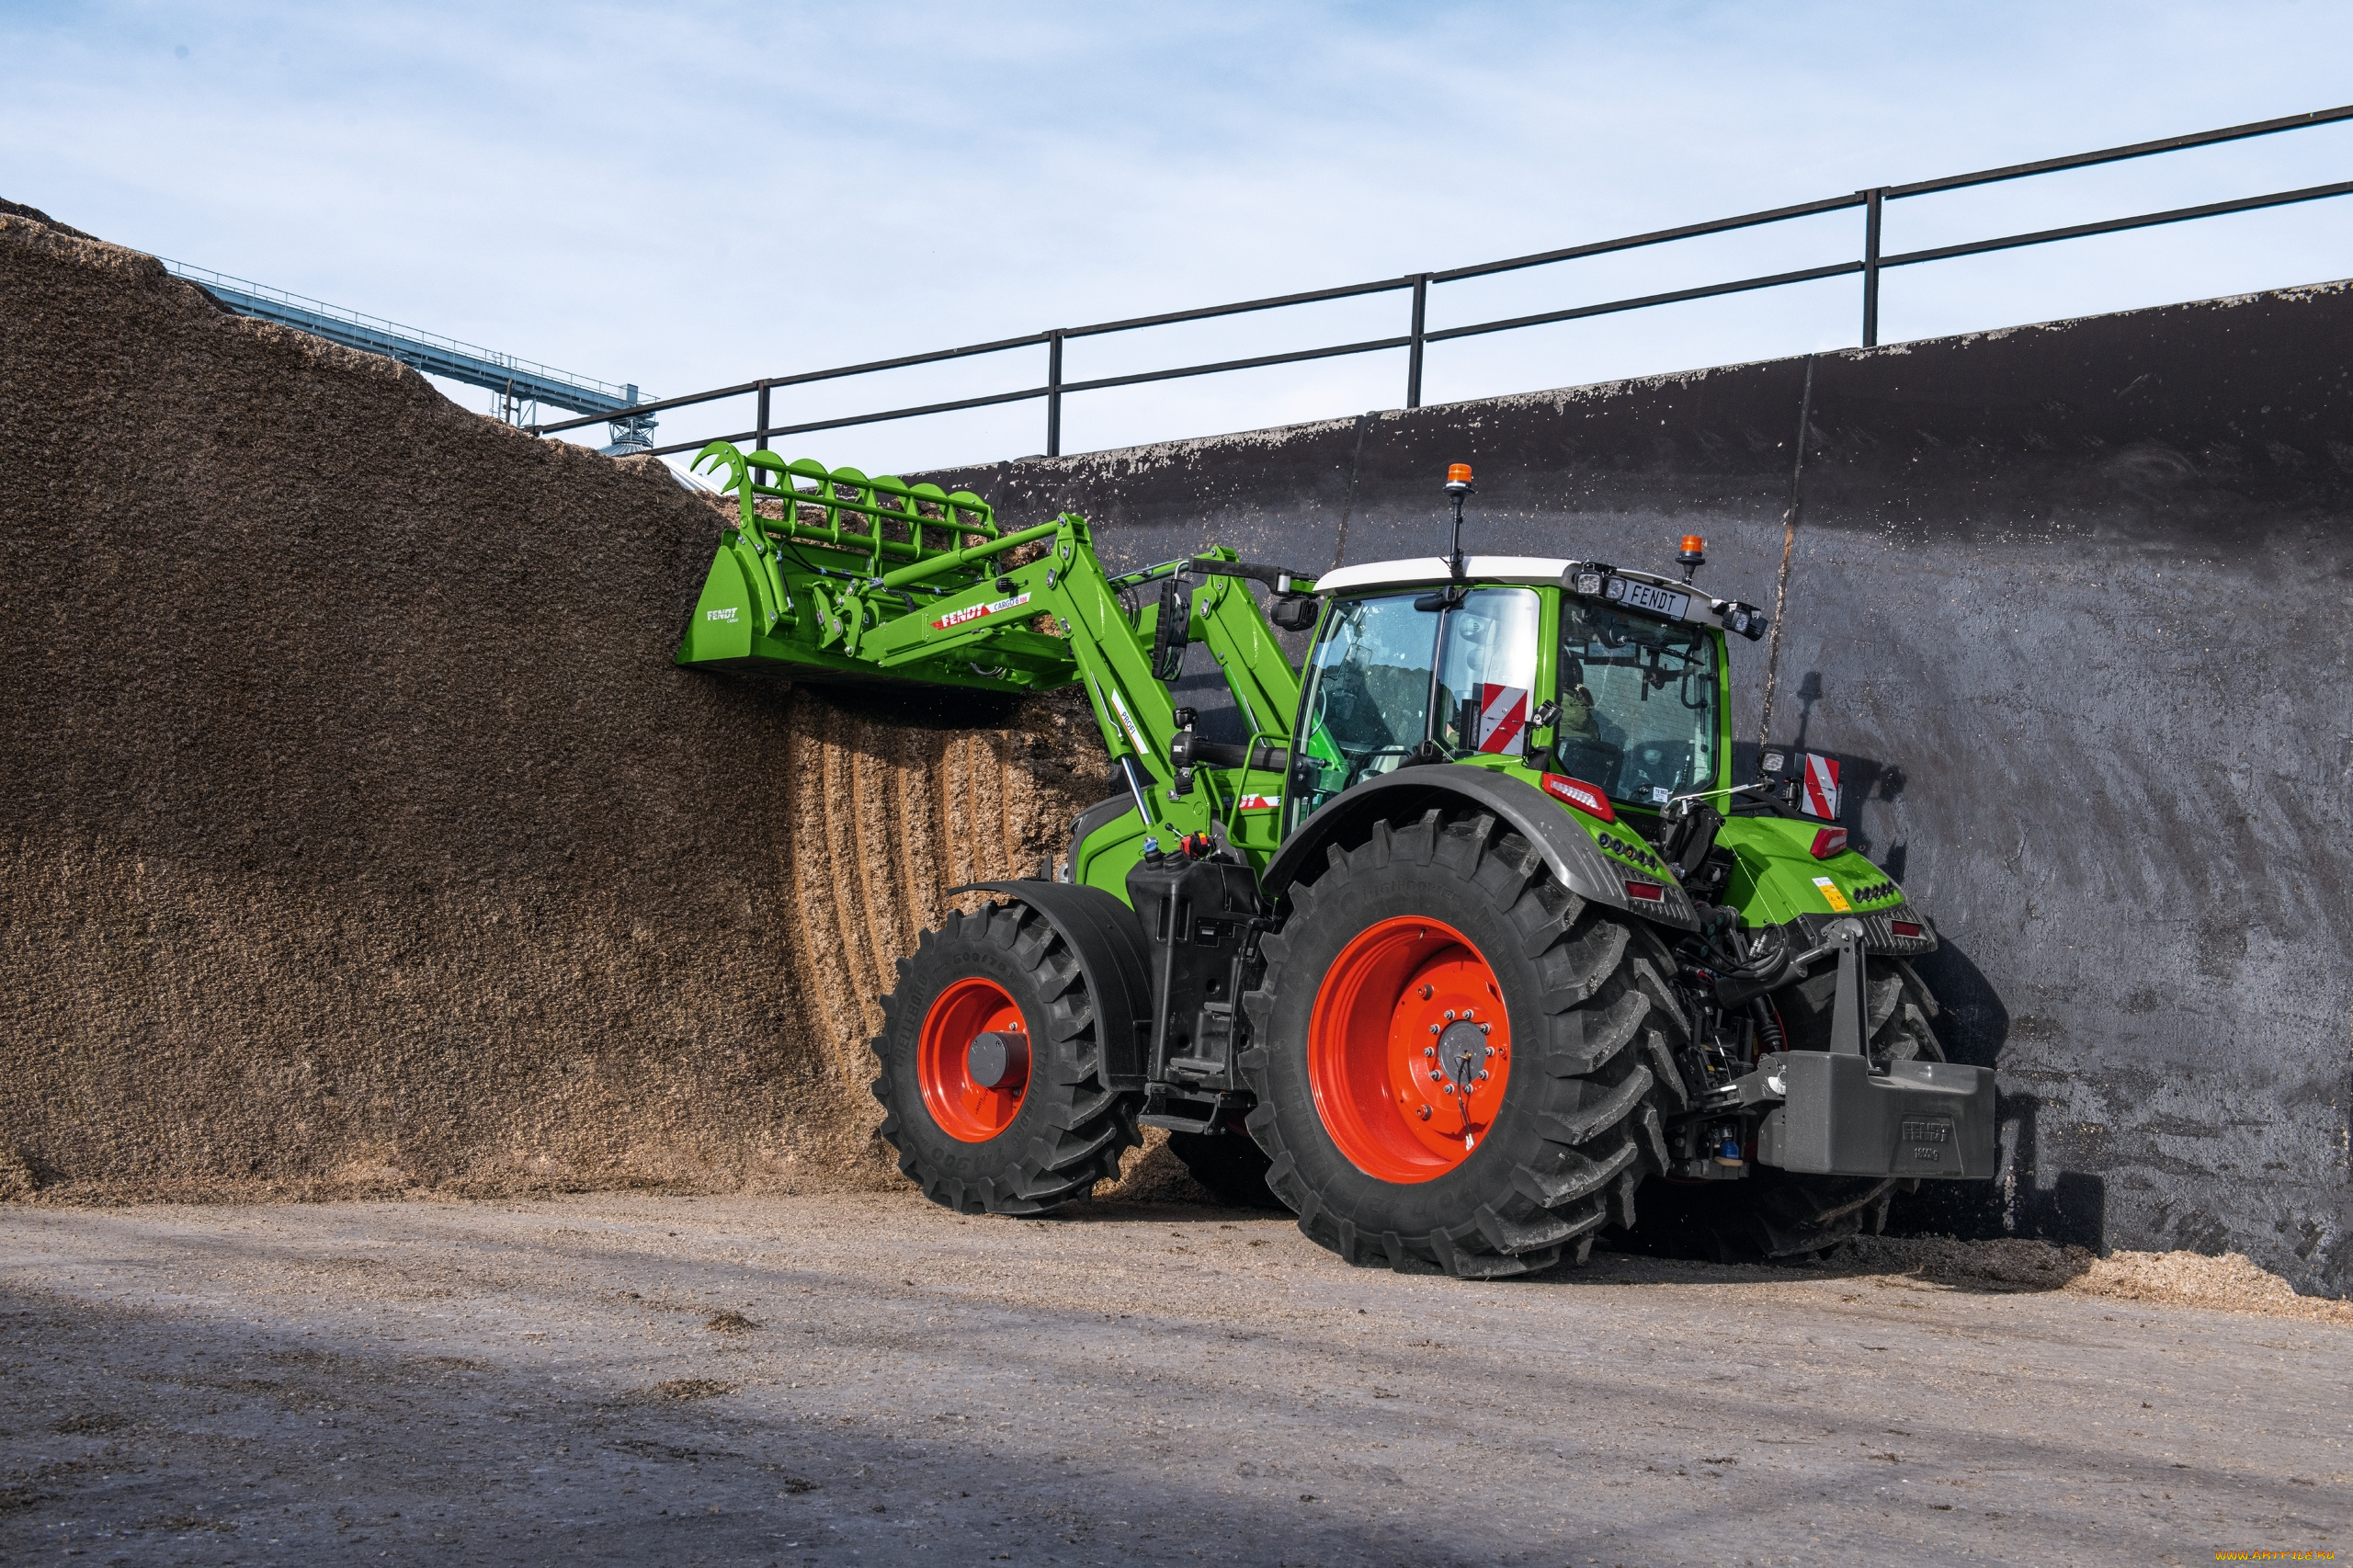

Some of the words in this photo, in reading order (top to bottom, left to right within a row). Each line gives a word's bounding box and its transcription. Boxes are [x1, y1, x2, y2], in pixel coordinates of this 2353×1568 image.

[1631, 585, 1676, 611] FENDT
[707, 607, 738, 620] FENDT
[941, 602, 984, 627] FENDT
[994, 598, 1015, 611] CARGO
[1015, 597, 1019, 605] 6
[1120, 710, 1136, 735] PROFI
[1902, 1121, 1950, 1142] FENDT
